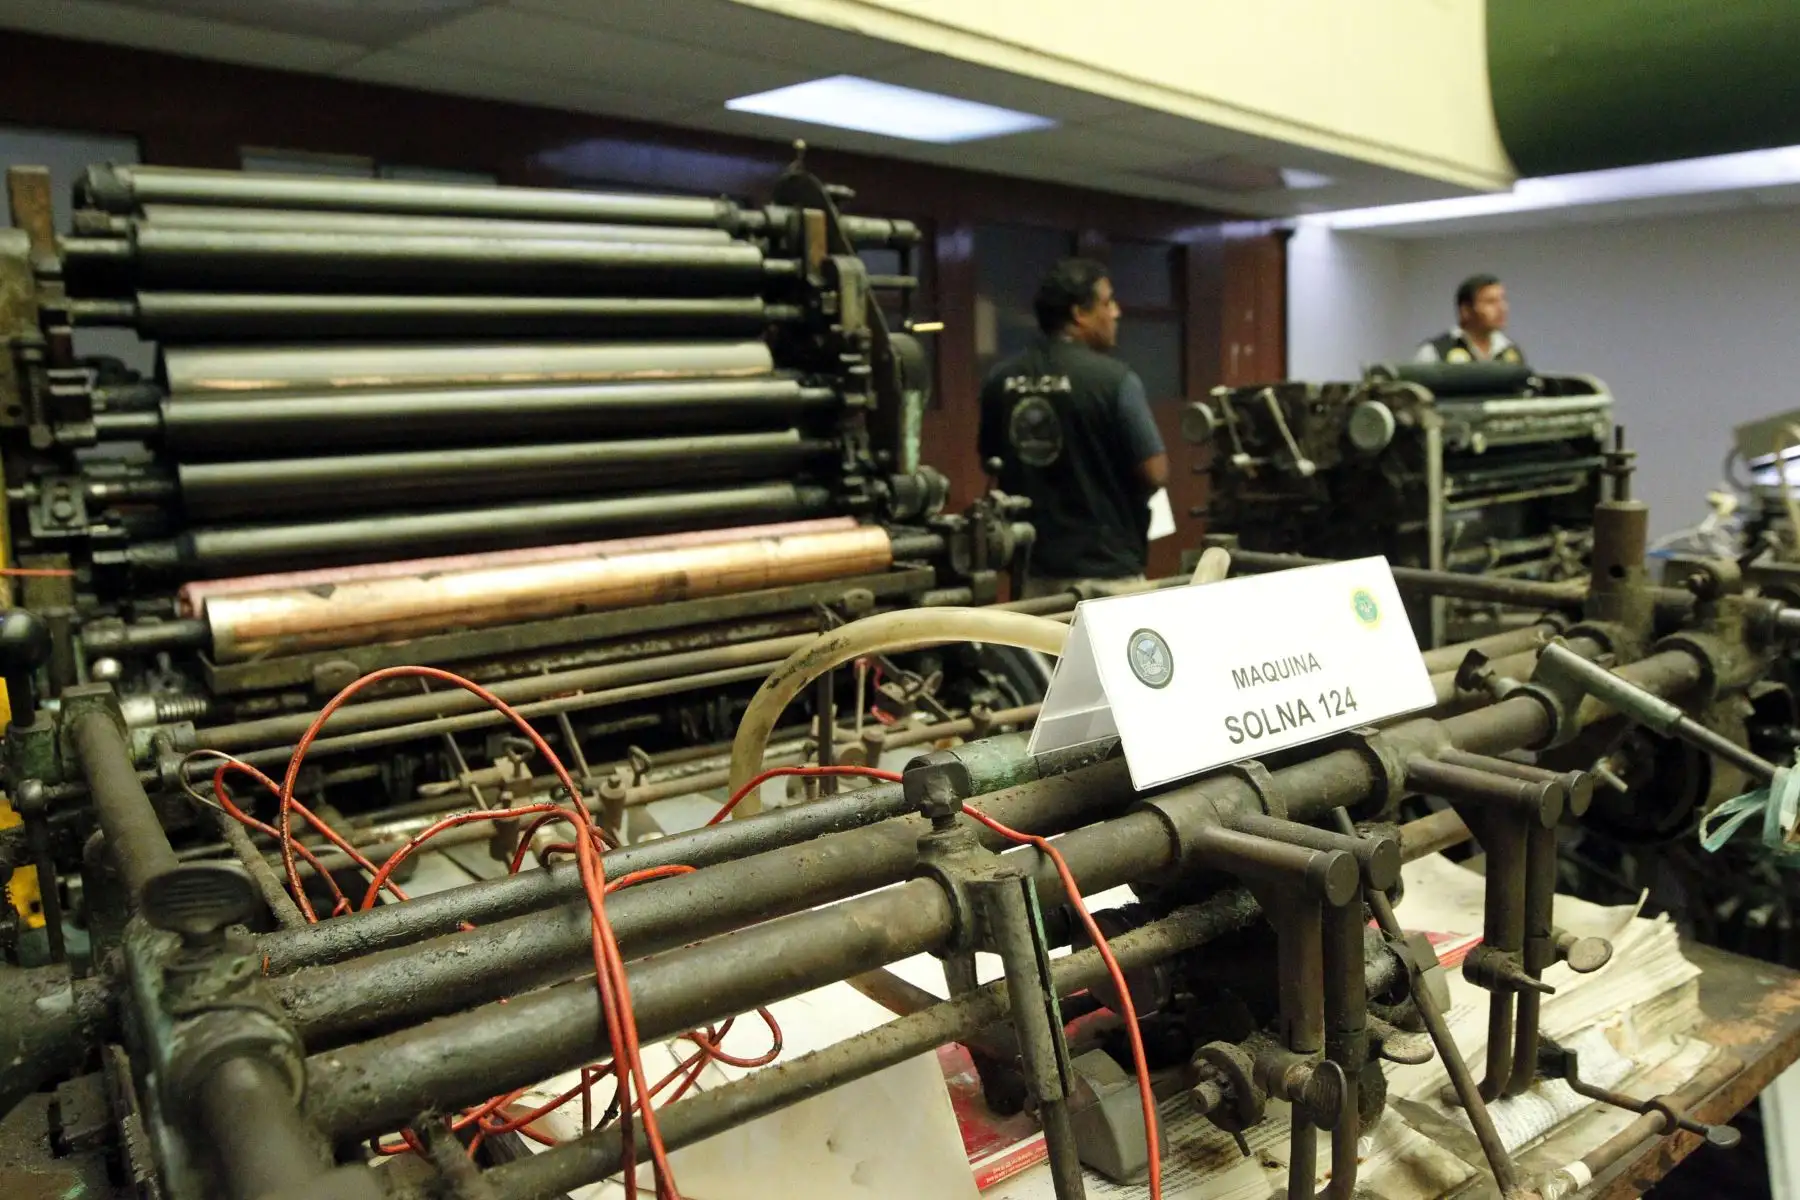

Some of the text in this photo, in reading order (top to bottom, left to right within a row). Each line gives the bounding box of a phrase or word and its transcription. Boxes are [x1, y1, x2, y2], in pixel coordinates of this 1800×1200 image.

[1231, 652, 1322, 690] MAQUINA
[1224, 686, 1357, 745] SOLNA 124
